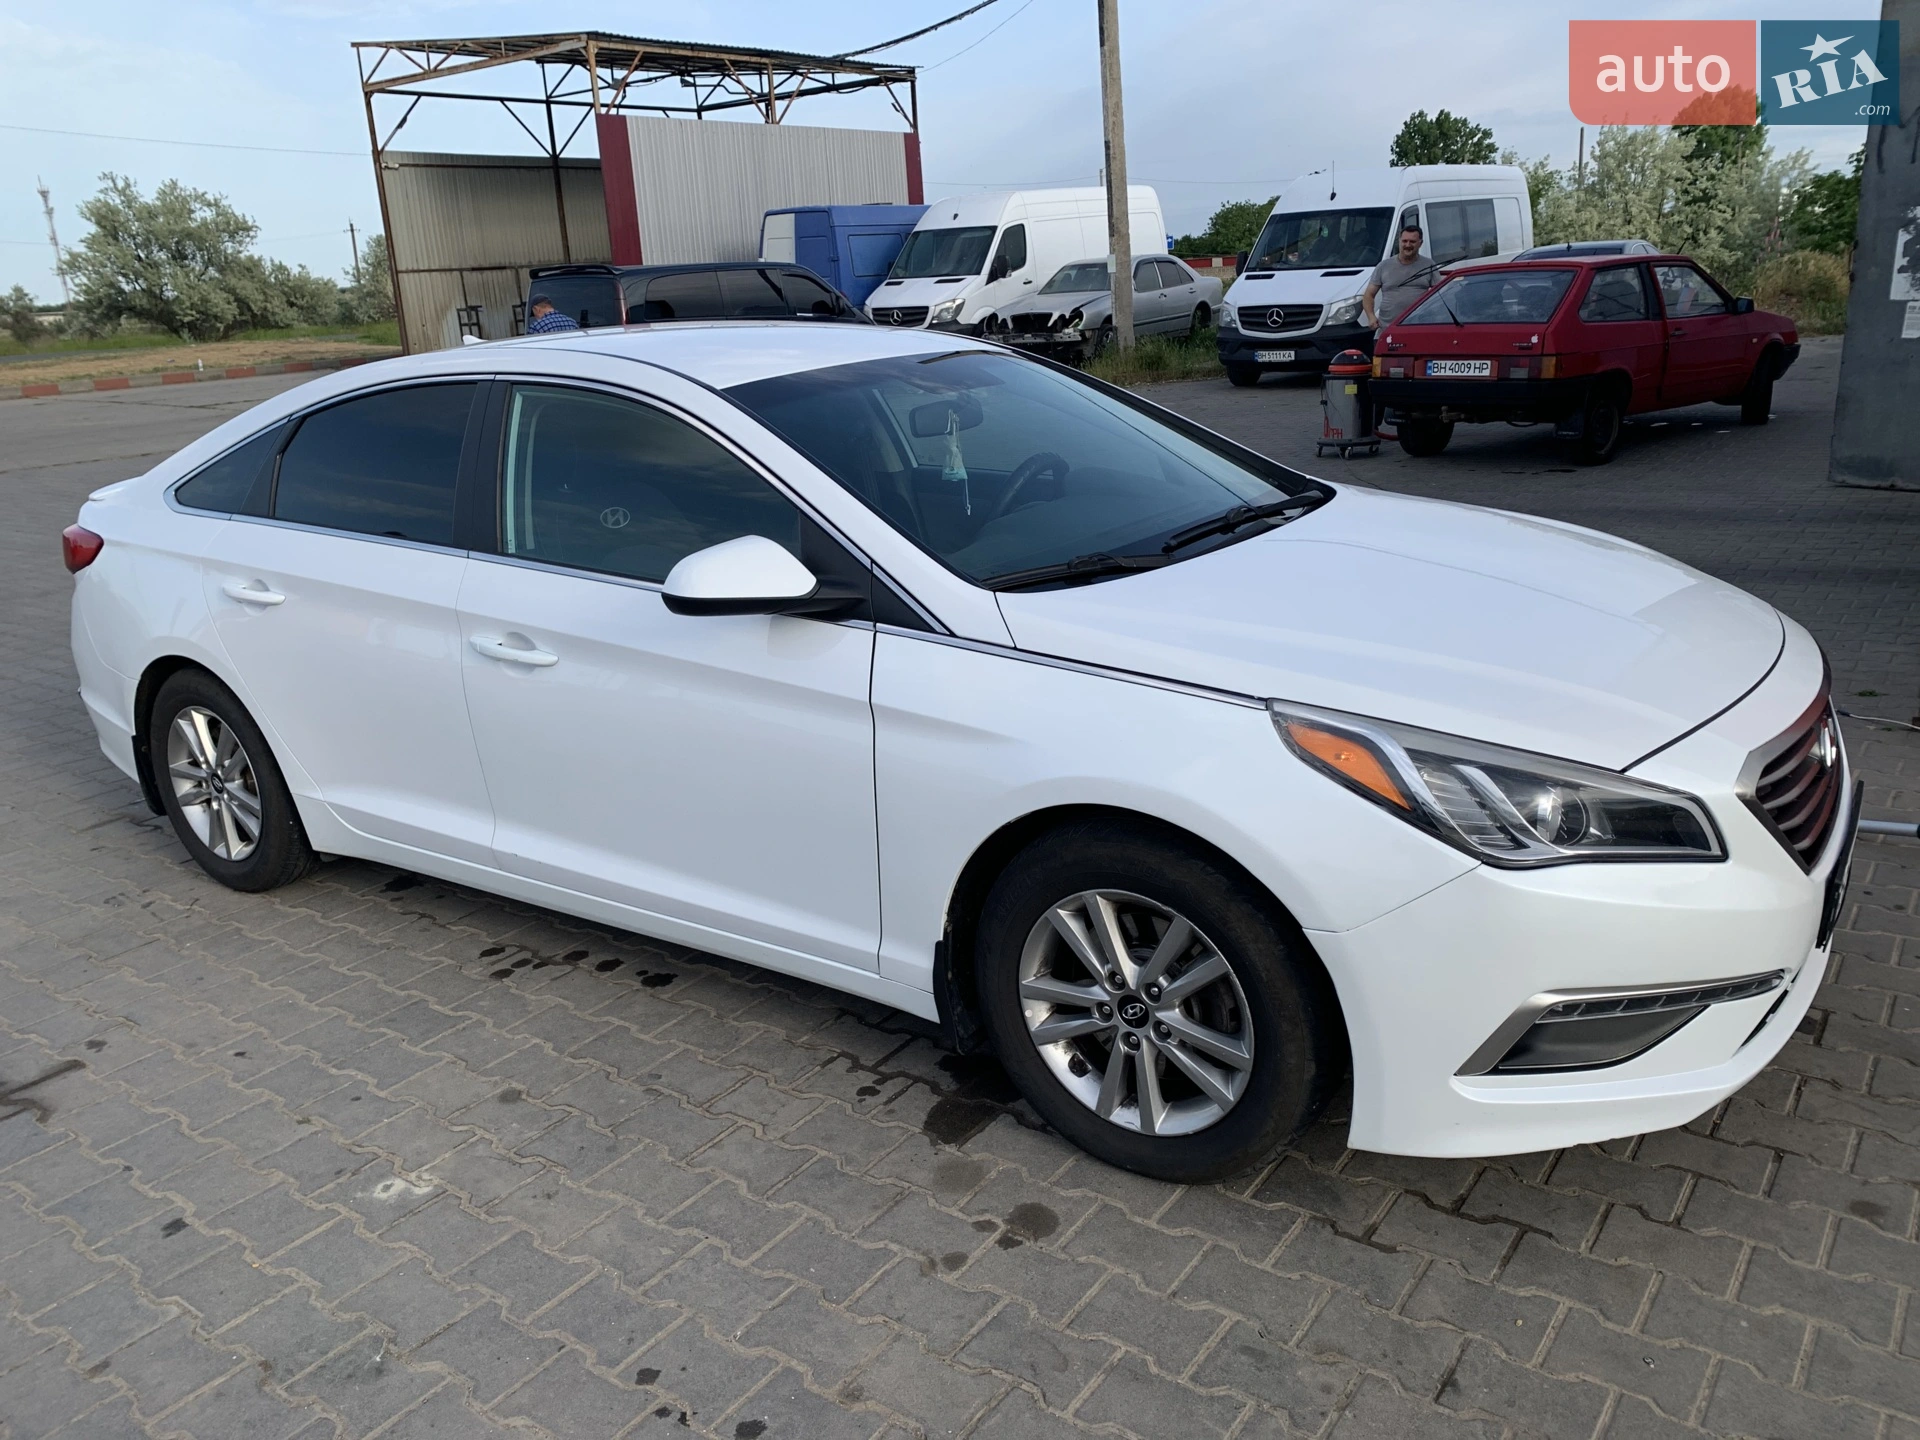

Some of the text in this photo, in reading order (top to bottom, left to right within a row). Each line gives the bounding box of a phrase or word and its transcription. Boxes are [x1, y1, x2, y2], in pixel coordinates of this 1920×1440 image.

[1432, 362, 1489, 374] BH 4009 HP
